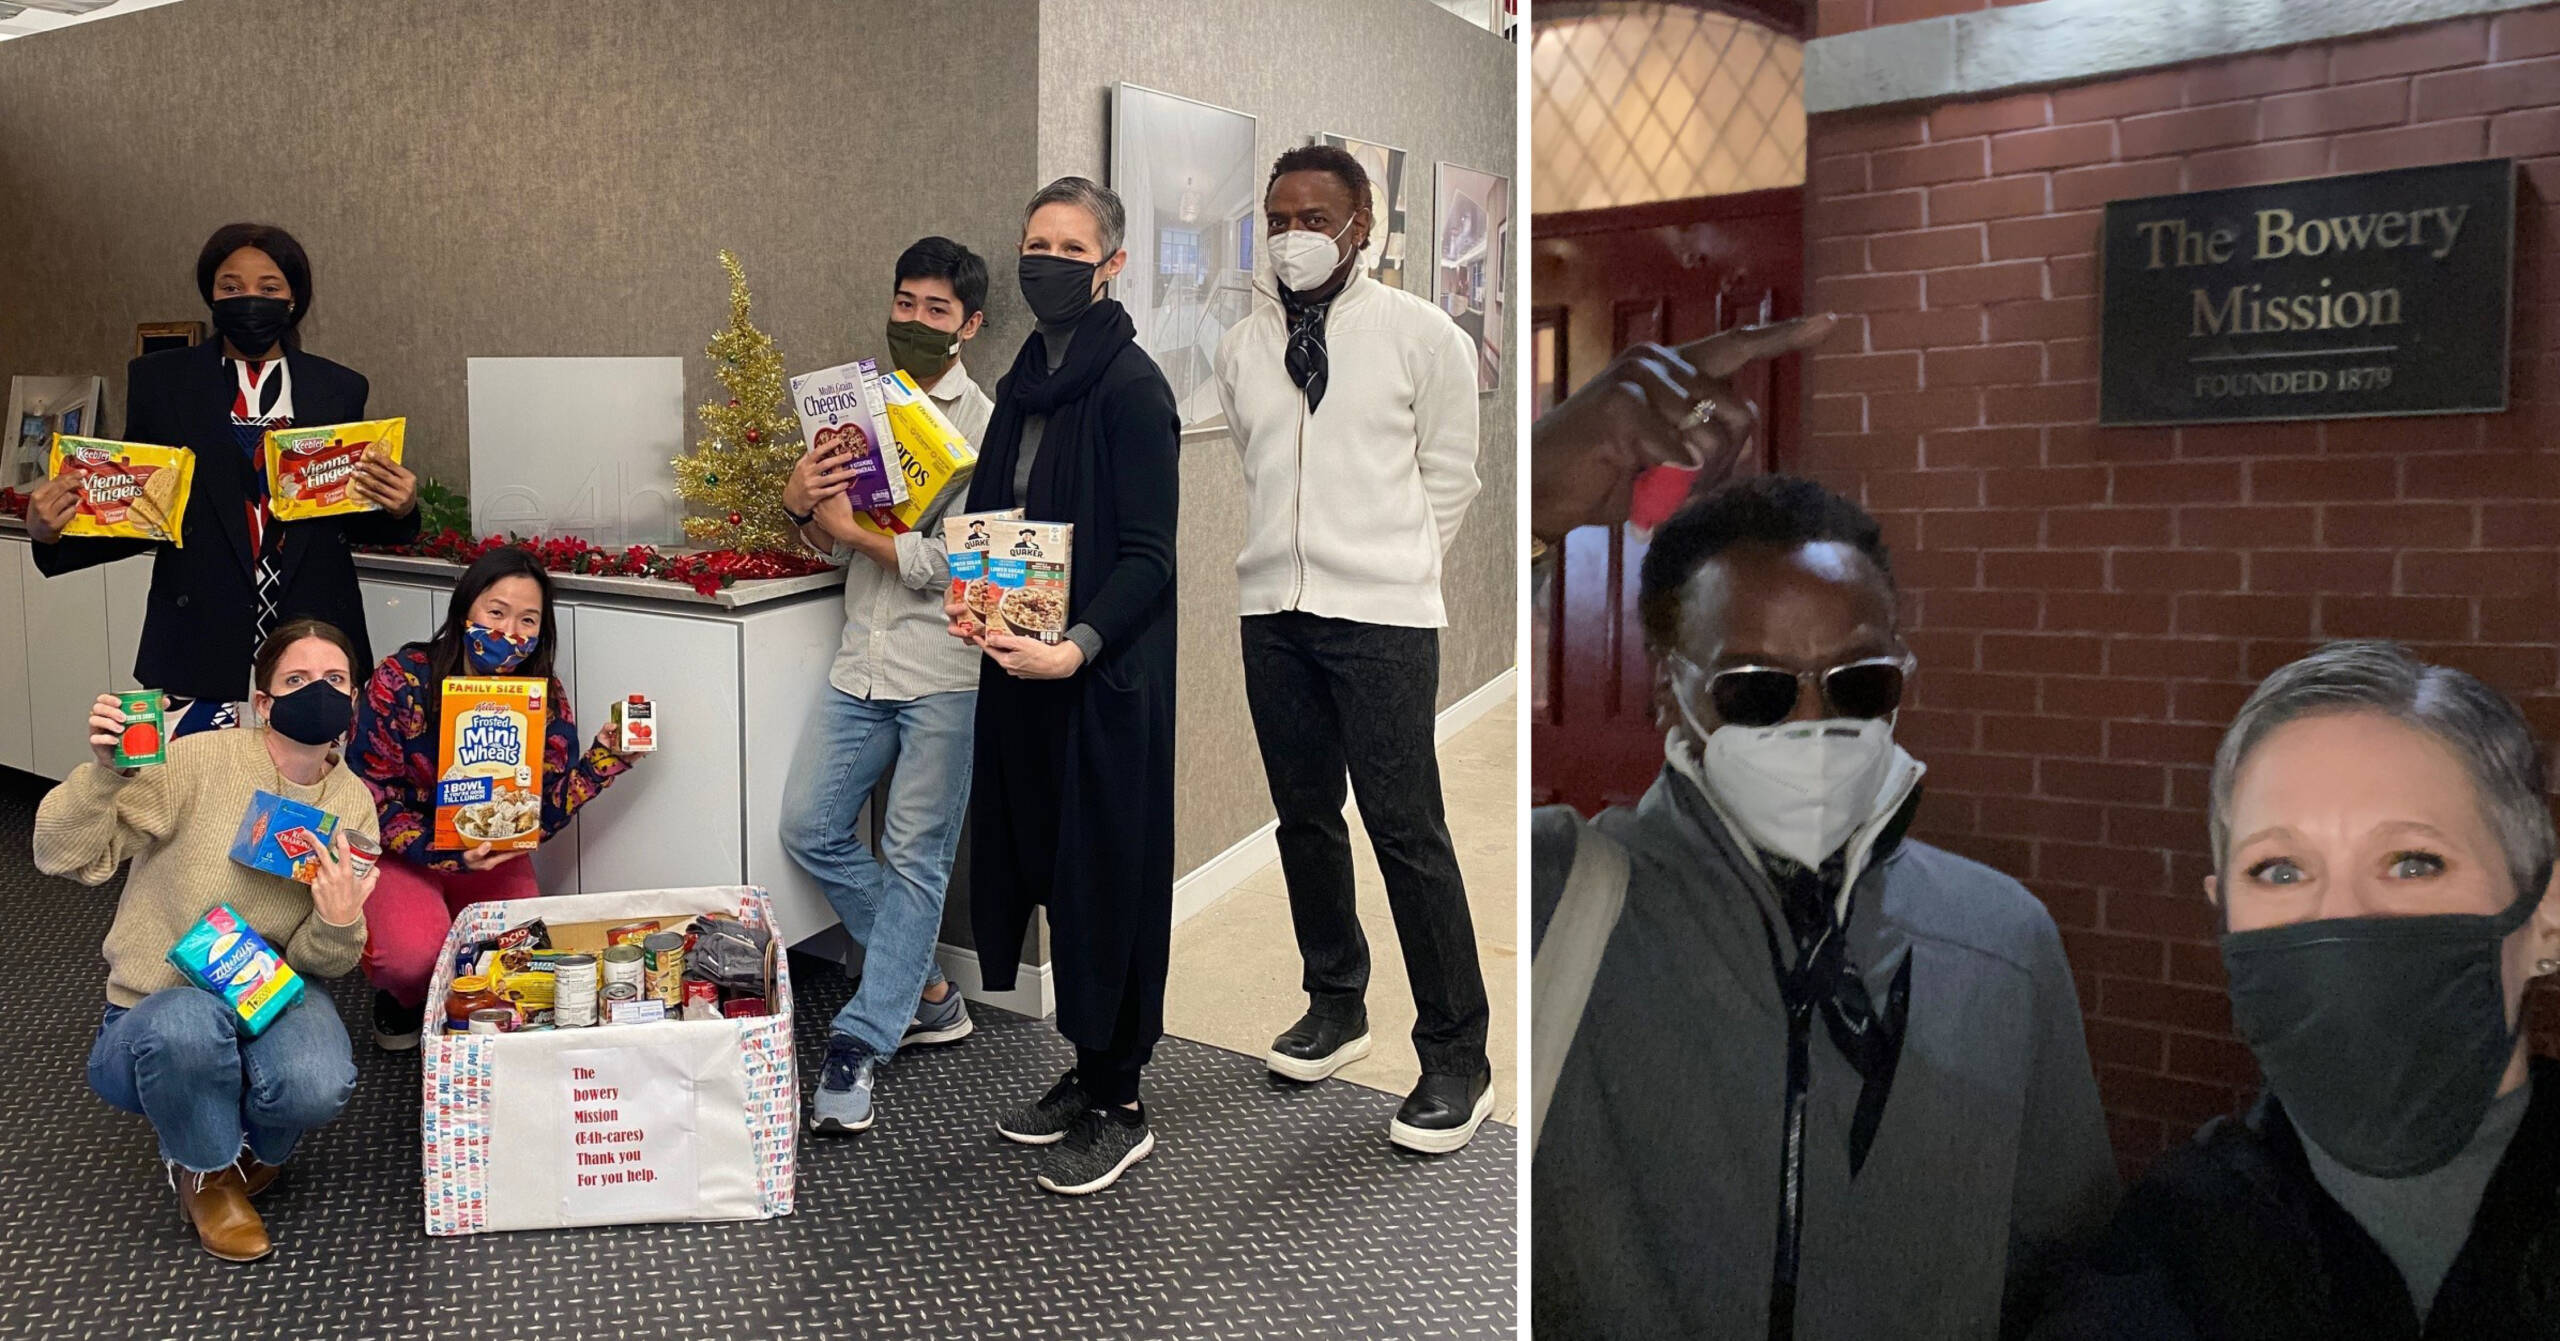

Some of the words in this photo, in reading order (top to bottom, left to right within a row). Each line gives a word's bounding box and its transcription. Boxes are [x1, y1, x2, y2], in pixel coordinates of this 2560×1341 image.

[2137, 220, 2235, 269] The
[2254, 205, 2469, 259] Bowery
[2189, 278, 2401, 337] Mission
[2196, 370, 2328, 397] FOUNDED
[2337, 366, 2393, 392] 1879
[804, 391, 857, 417] Cheerios
[294, 439, 323, 451] Keebler
[77, 447, 109, 461] Keebler
[300, 454, 350, 477] Vienna
[81, 473, 135, 490] Vienna
[88, 485, 143, 503] Fingers
[965, 540, 990, 549] QUAKE
[1010, 549, 1044, 558] QUAKER
[449, 683, 492, 693] FAMILY
[497, 685, 524, 693] SIZE
[473, 716, 509, 728] Frosted
[465, 726, 517, 748] Mini
[460, 744, 519, 765] Wheats
[451, 780, 485, 792] BOWL
[460, 794, 485, 802] LUNCH
[573, 1068, 595, 1080] The
[573, 1088, 618, 1102] bowery
[574, 1109, 618, 1123] Mission
[575, 1129, 644, 1145] (E4h-cares)
[577, 1152, 615, 1165] Thank
[619, 1150, 641, 1164] you
[578, 1174, 597, 1186] For
[601, 1173, 623, 1187] you
[627, 1169, 658, 1182] help.
